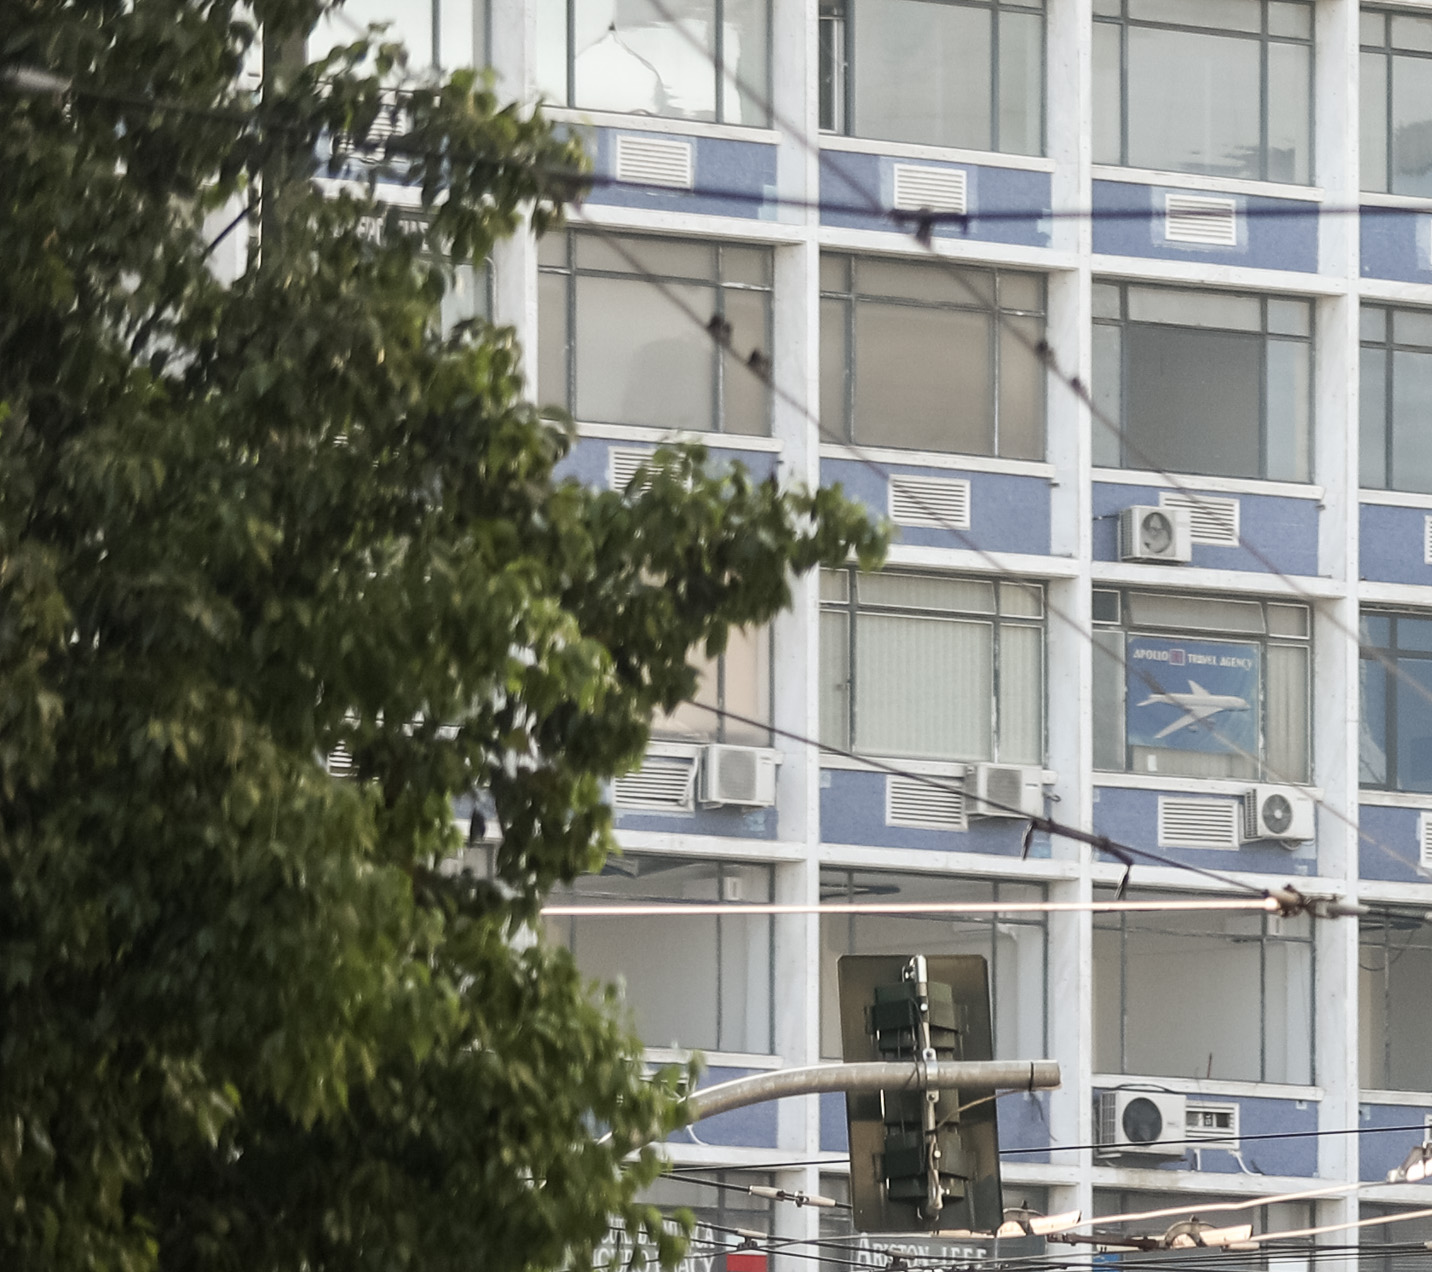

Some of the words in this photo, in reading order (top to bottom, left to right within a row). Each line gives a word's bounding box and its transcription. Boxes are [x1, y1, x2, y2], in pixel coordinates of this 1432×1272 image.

[1132, 648, 1168, 661] APOLLO
[1187, 653, 1216, 666] TRAVEL
[1219, 657, 1252, 671] AGENCY
